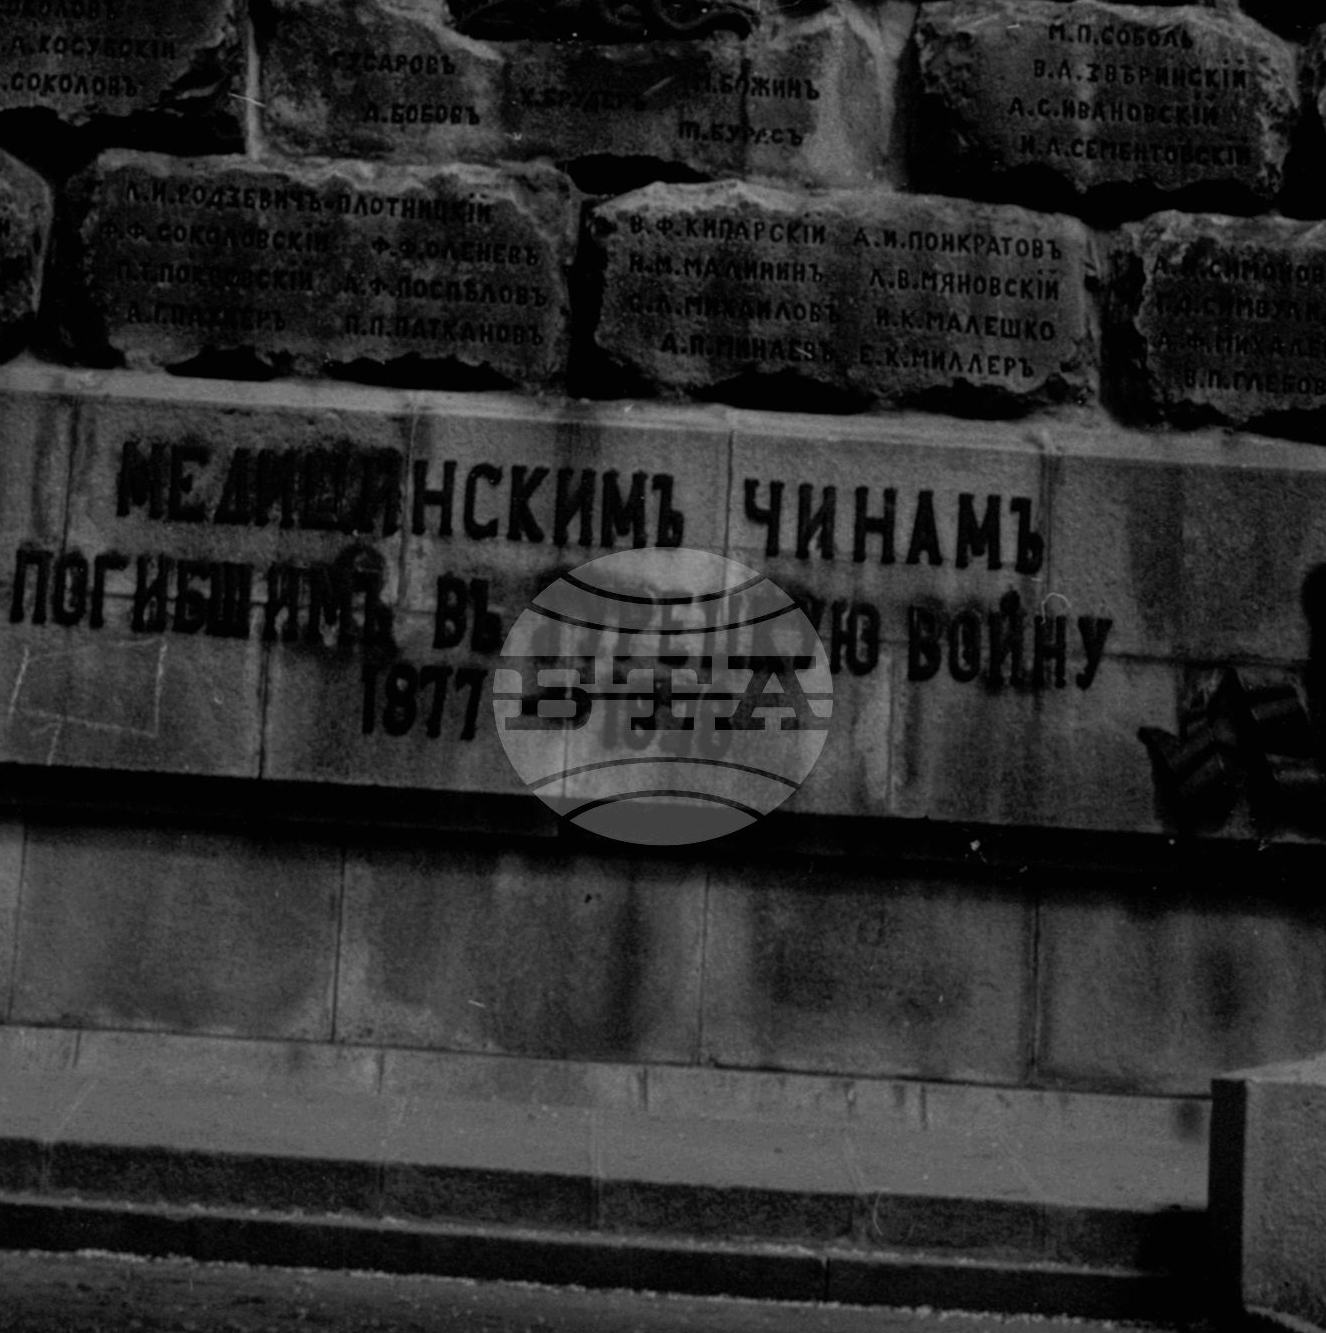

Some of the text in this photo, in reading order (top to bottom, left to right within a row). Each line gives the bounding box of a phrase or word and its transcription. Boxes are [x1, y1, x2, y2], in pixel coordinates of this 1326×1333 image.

[860, 345, 1034, 378] Е.К.МИЛЛЕРЪ
[117, 441, 1043, 574] МЕДИЦИНСКИМЪ ЧИНАМЪ
[11, 549, 395, 653] ПОГИБШИМЪ
[433, 574, 502, 653] ВЪ
[907, 590, 1112, 691] ВОЙНУ
